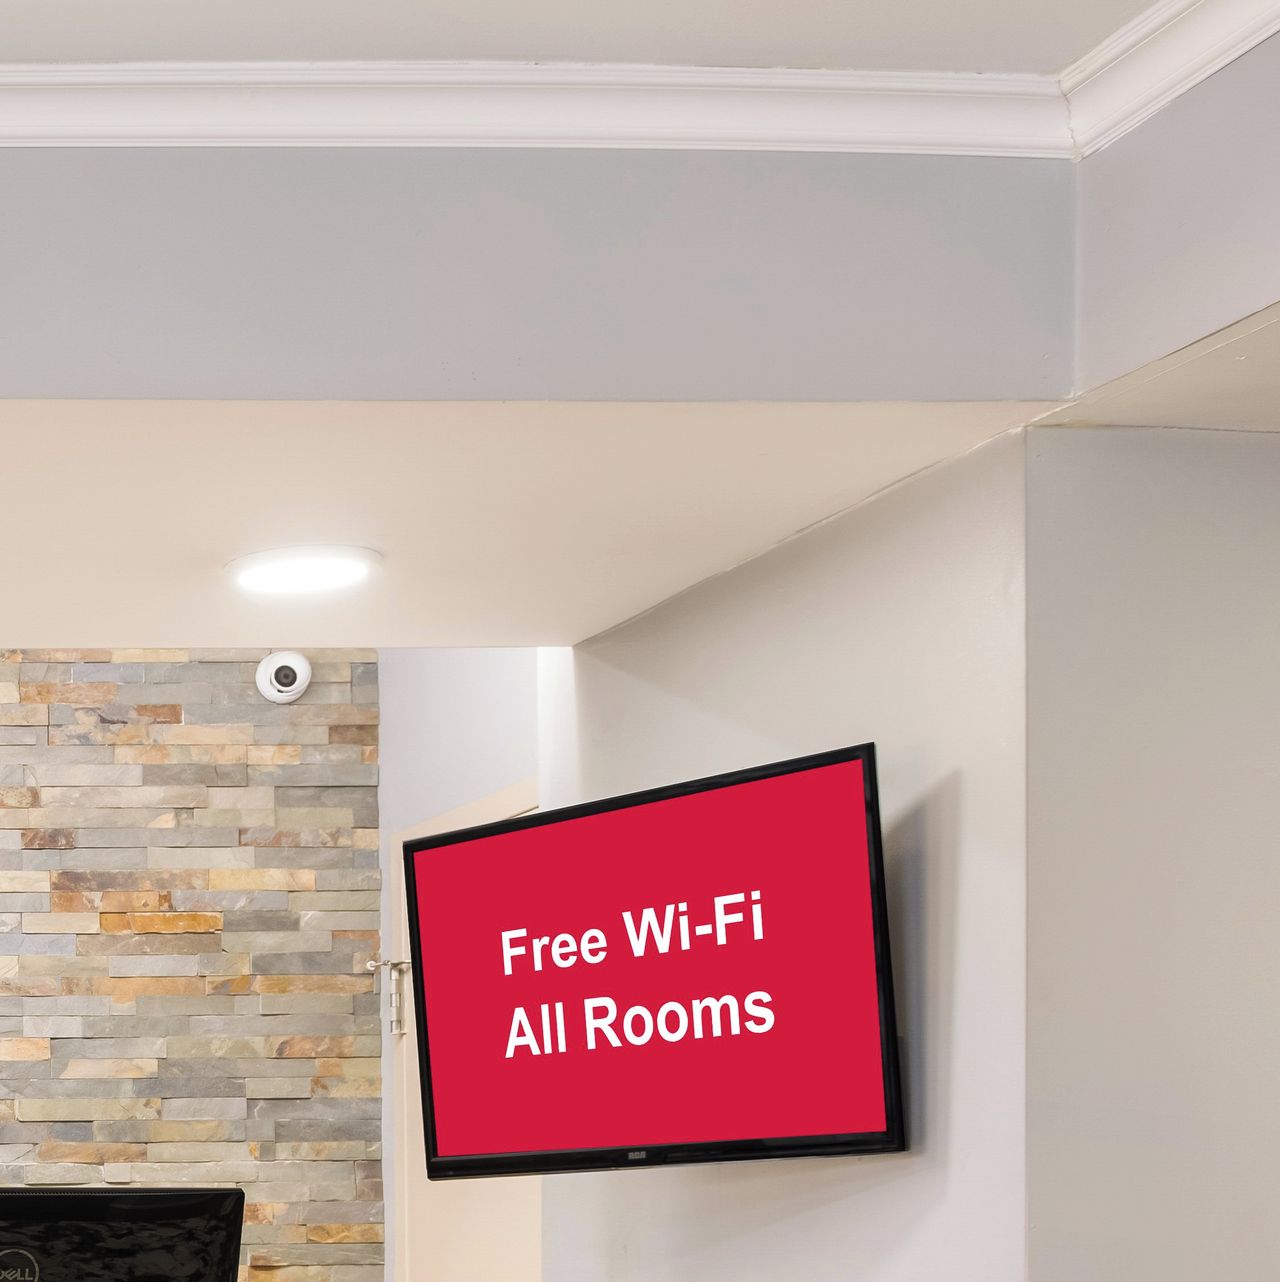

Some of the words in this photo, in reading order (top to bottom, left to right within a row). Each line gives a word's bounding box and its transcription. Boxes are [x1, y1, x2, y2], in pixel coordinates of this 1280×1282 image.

[501, 928, 608, 976] Free
[622, 890, 764, 957] Wi-Fi
[504, 1001, 567, 1059] All
[583, 990, 776, 1050] Rooms
